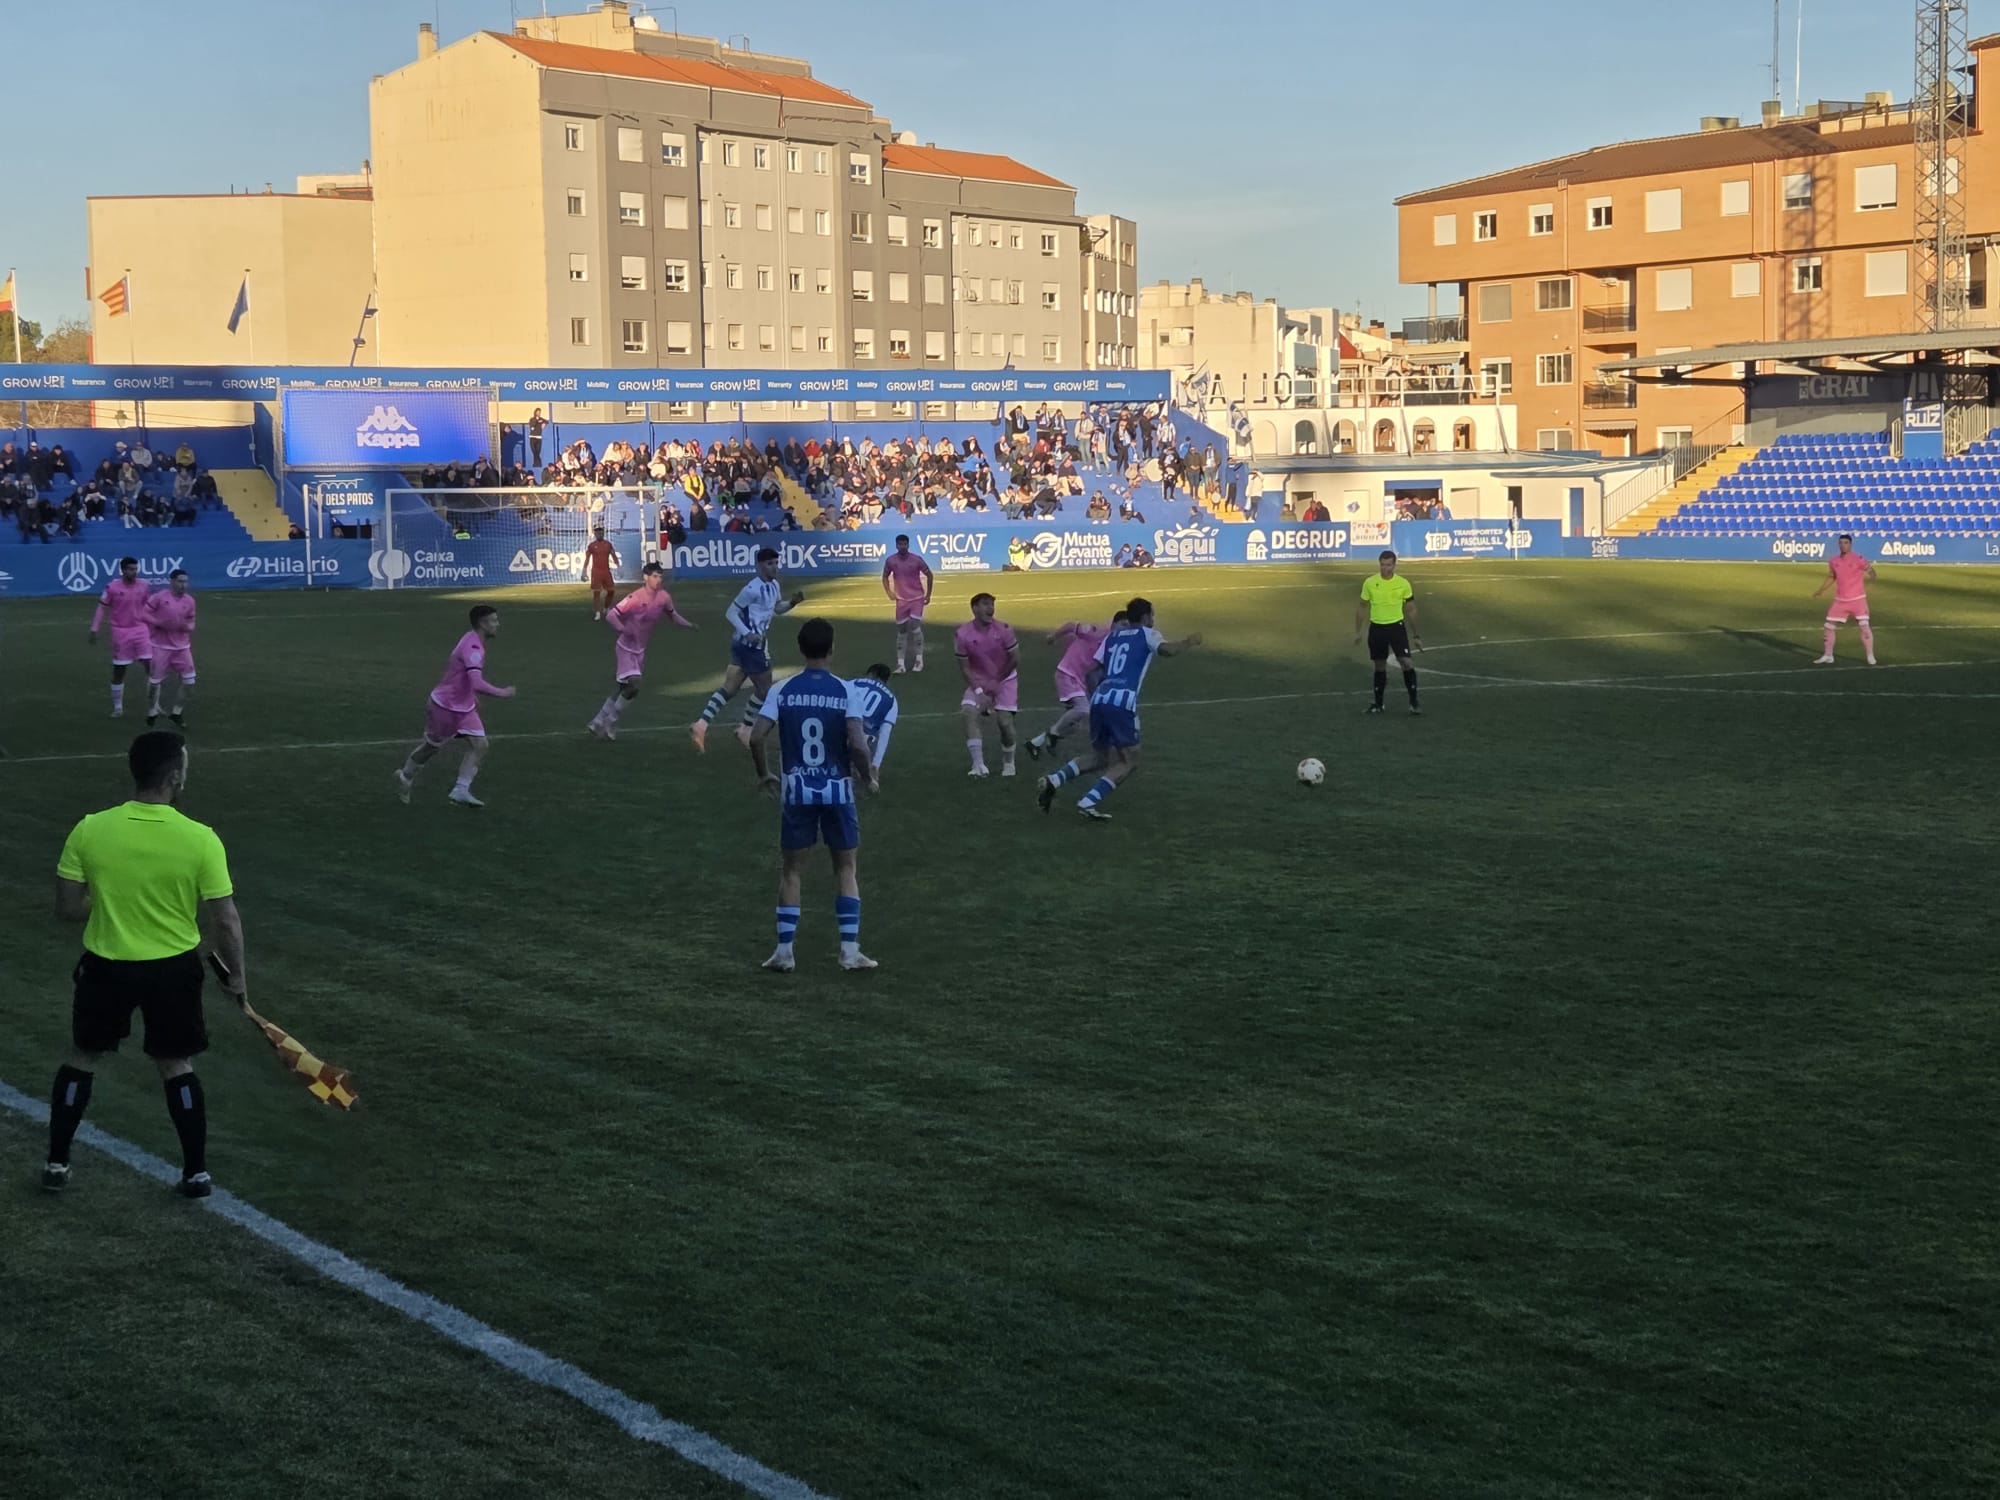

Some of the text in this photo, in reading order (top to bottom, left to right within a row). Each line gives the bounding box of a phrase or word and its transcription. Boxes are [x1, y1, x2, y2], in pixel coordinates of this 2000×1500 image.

[3, 378, 42, 388] GROW
[114, 379, 152, 388] GROW
[222, 380, 258, 389] GROW
[524, 381, 558, 390] GROW
[618, 382, 650, 391] GROW
[710, 382, 742, 391] GROW
[800, 382, 830, 391] GROW
[886, 382, 916, 392] GROW
[971, 382, 1000, 392] GROW
[1054, 382, 1082, 392] GROW
[1906, 412, 1940, 428] RUIZ
[356, 432, 420, 448] Kappa
[326, 493, 346, 506] DELS
[347, 492, 374, 505] PATOS
[916, 532, 988, 554] VERICAT
[1064, 532, 1110, 546] Mutua
[1272, 529, 1347, 550] DEGRUP
[818, 544, 886, 558] SYSTEM
[1062, 544, 1112, 558] Levante
[1772, 540, 1825, 558] Digicopy
[1894, 541, 1936, 556] Replus
[414, 550, 454, 562] Caixa
[1062, 558, 1112, 566] SEGUROS
[264, 556, 339, 573] Hilario
[1108, 642, 1130, 676] 16
[801, 717, 826, 767] 8
